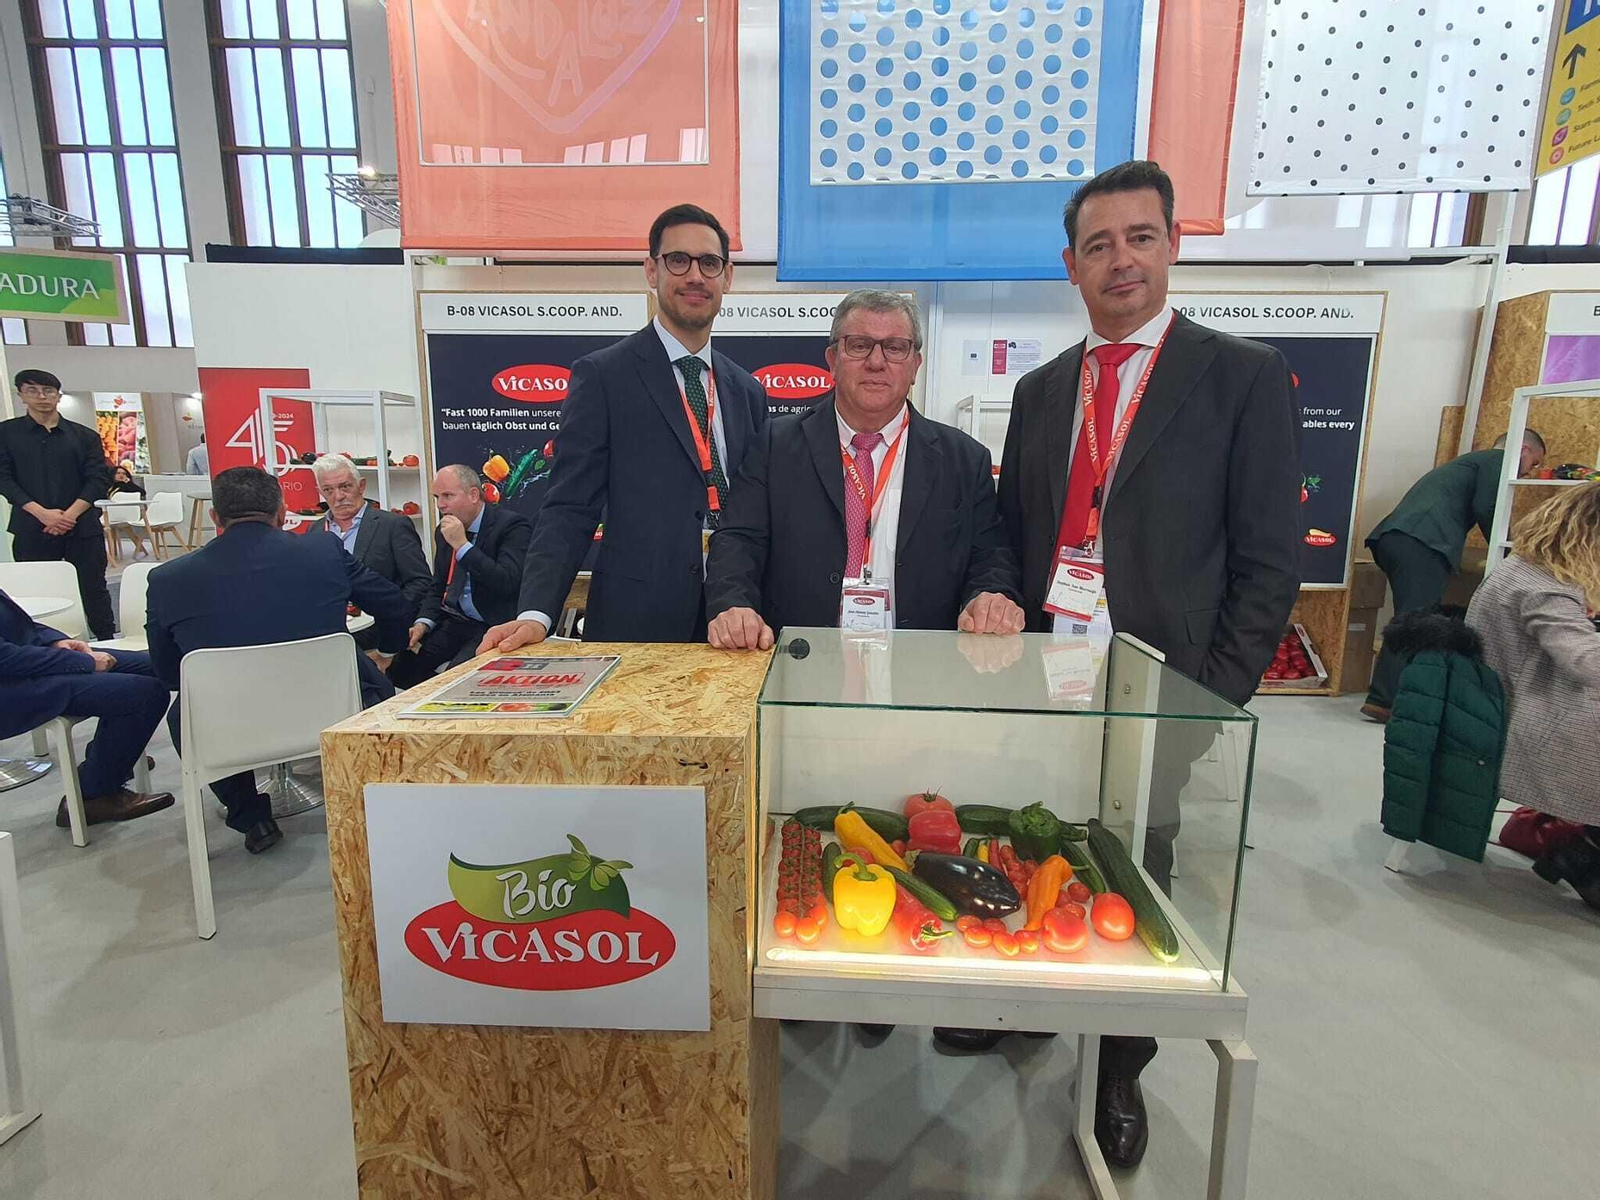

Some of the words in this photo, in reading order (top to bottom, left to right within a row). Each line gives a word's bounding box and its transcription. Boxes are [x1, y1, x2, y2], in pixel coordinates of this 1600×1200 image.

[447, 306, 475, 316] B-08
[478, 306, 534, 317] VICASOL
[537, 306, 588, 317] S.COOP.
[591, 306, 622, 317] AND.
[737, 307, 794, 318] VICASOL
[1199, 307, 1259, 318] VICASOL
[1262, 308, 1317, 319] S.COOP.
[1320, 308, 1354, 319] AND.
[467, 409, 488, 417] 1000
[490, 408, 530, 417] Familien
[778, 405, 789, 413] de
[1303, 407, 1324, 416] from
[1326, 408, 1342, 416] our
[442, 422, 470, 430] bauen
[471, 421, 503, 433] täglich
[505, 422, 527, 431] Obst
[529, 422, 547, 431] und
[1328, 422, 1355, 431] every
[484, 674, 578, 684] AKTION
